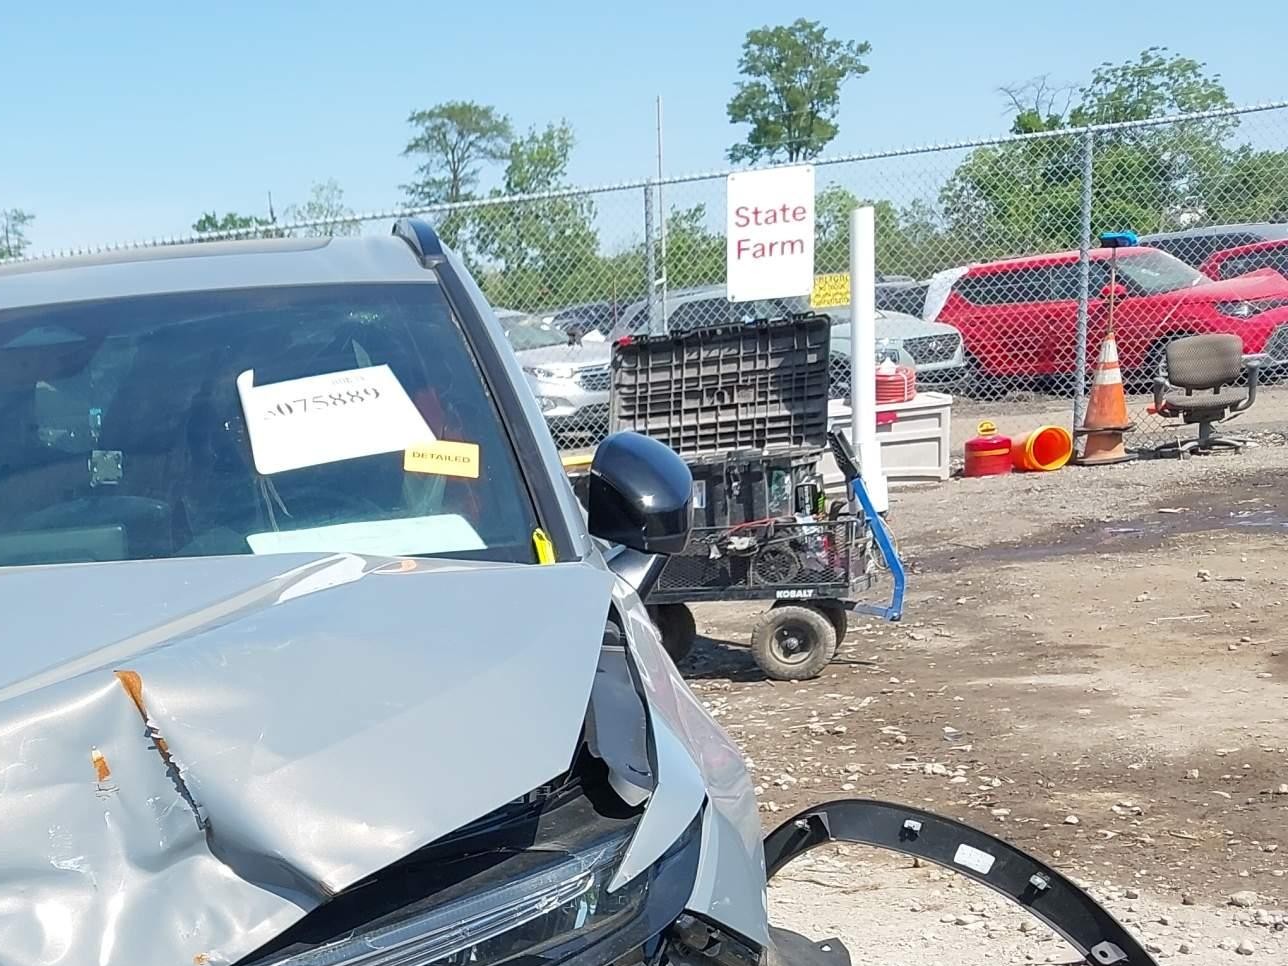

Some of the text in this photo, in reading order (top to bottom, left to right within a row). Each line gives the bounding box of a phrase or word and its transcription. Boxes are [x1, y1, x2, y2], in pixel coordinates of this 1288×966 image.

[735, 204, 807, 228] State
[737, 238, 805, 260] Farm
[412, 451, 471, 464] DETAILED
[776, 589, 814, 599] KOBALT
